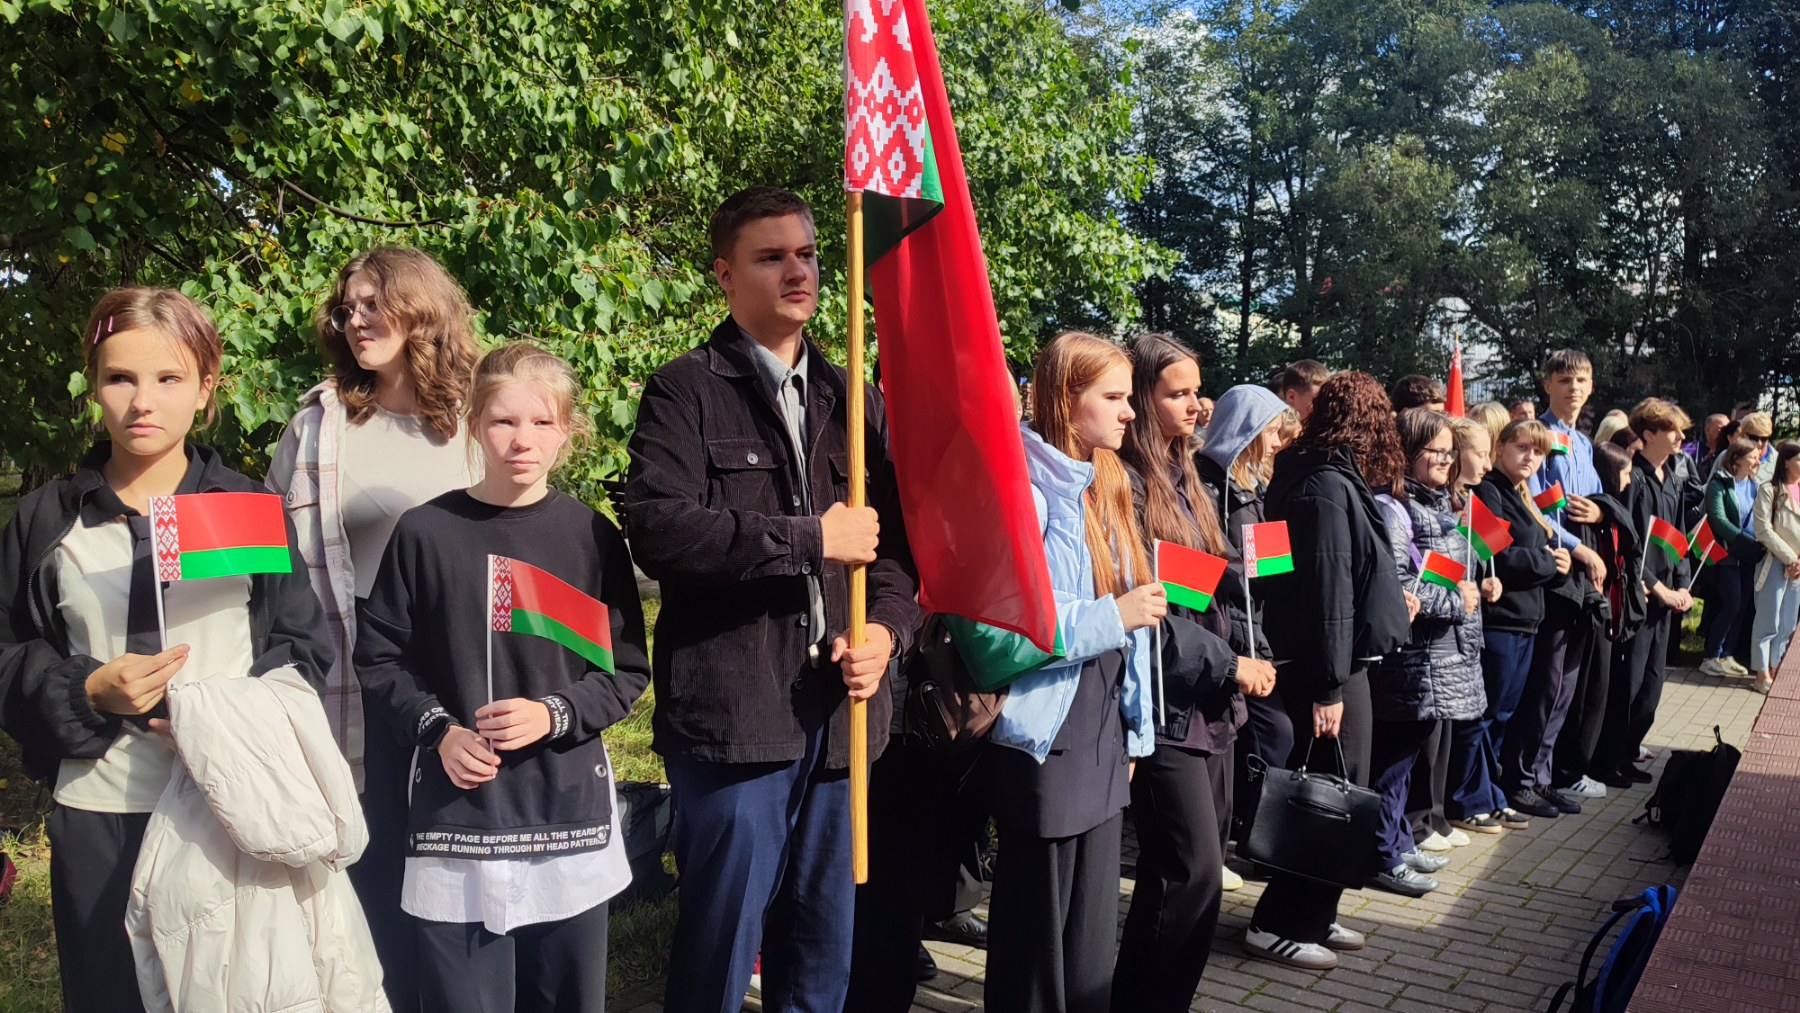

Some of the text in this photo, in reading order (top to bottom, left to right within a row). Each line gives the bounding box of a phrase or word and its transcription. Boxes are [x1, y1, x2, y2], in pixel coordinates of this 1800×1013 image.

[552, 698, 565, 713] ALL
[425, 832, 453, 841] EMPTY
[454, 833, 480, 843] PAGE
[482, 834, 518, 844] BEFORE
[519, 834, 532, 842] ME
[533, 833, 550, 841] ALL
[550, 831, 569, 840] THE
[570, 827, 597, 838] YEARS
[451, 845, 491, 855] RUNNING
[493, 844, 532, 854] THROUGH
[533, 844, 546, 852] MY
[546, 841, 569, 851] HEAD
